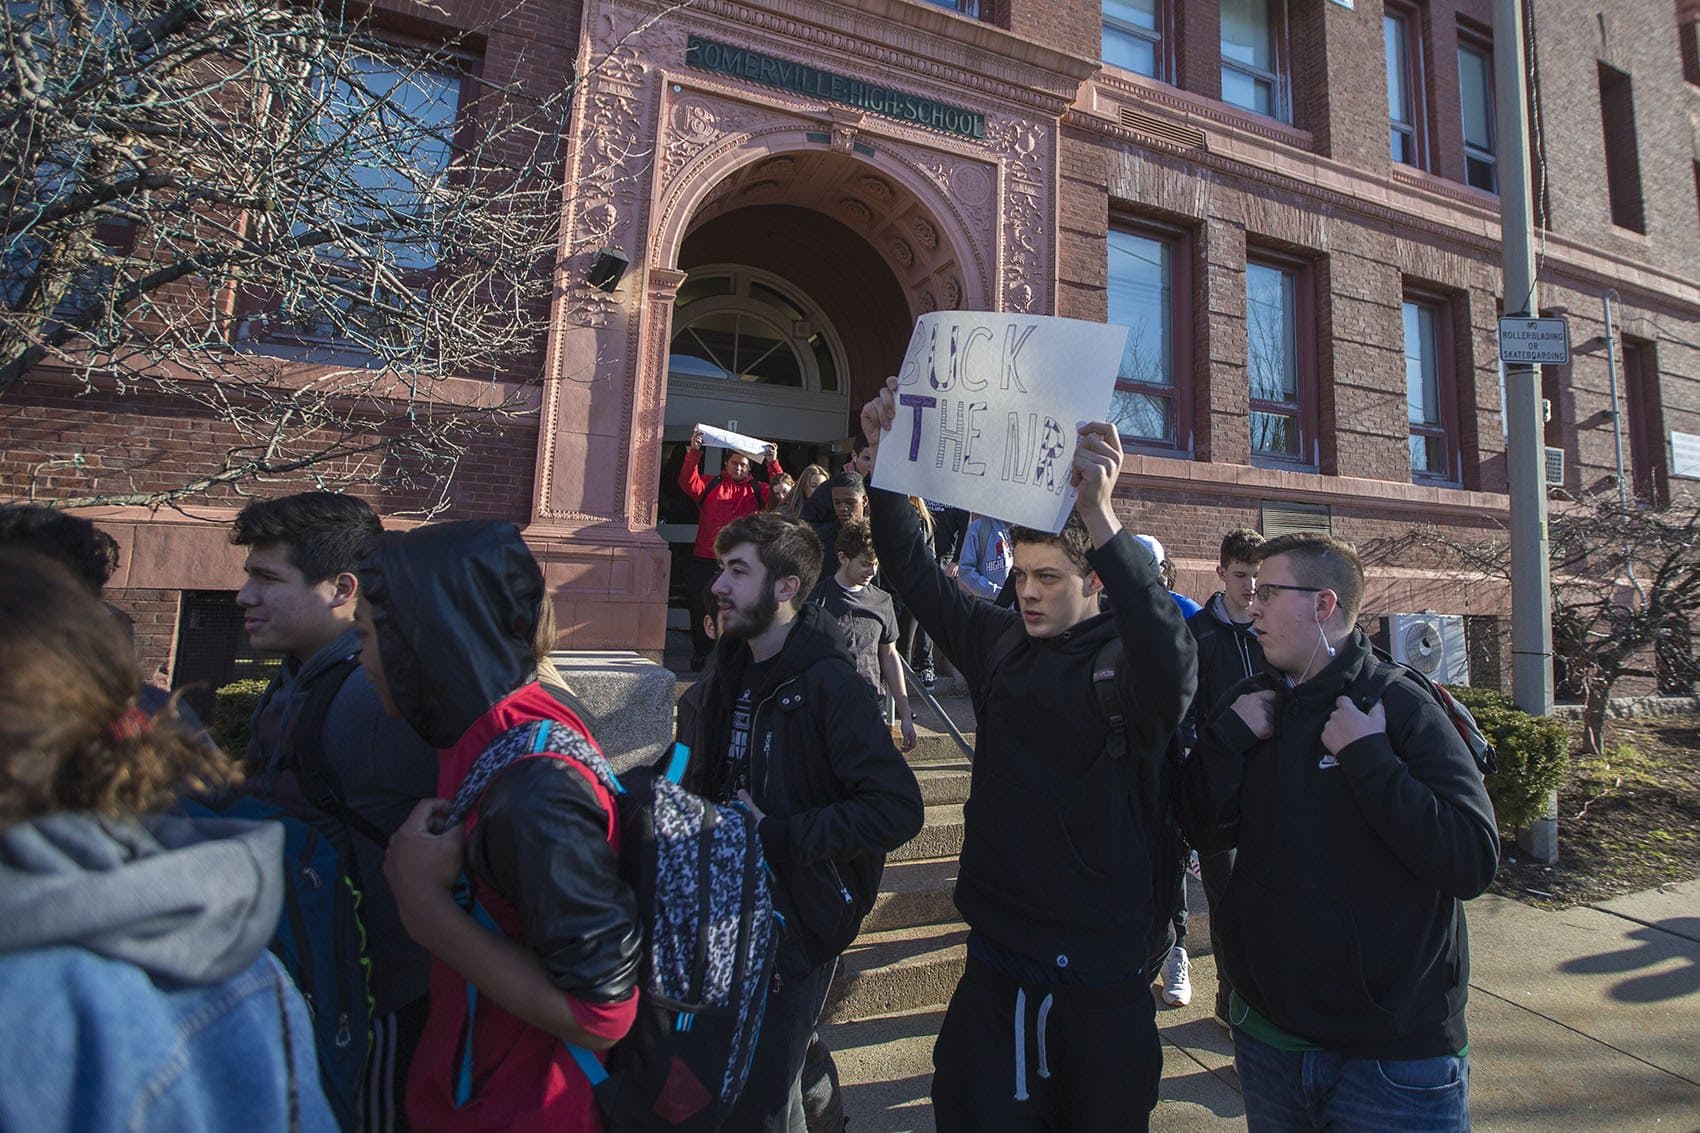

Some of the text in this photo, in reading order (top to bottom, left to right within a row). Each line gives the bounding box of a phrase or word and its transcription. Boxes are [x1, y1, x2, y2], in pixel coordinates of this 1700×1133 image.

[849, 84, 900, 115] HIGH
[903, 96, 984, 138] SCHOOL
[1503, 331, 1564, 340] ROLLERBLADING
[897, 320, 1038, 394] BUCK
[1504, 351, 1565, 360] SKATEBOARDING
[899, 393, 1073, 496] THE NR
[985, 558, 1005, 573] HIGHL
